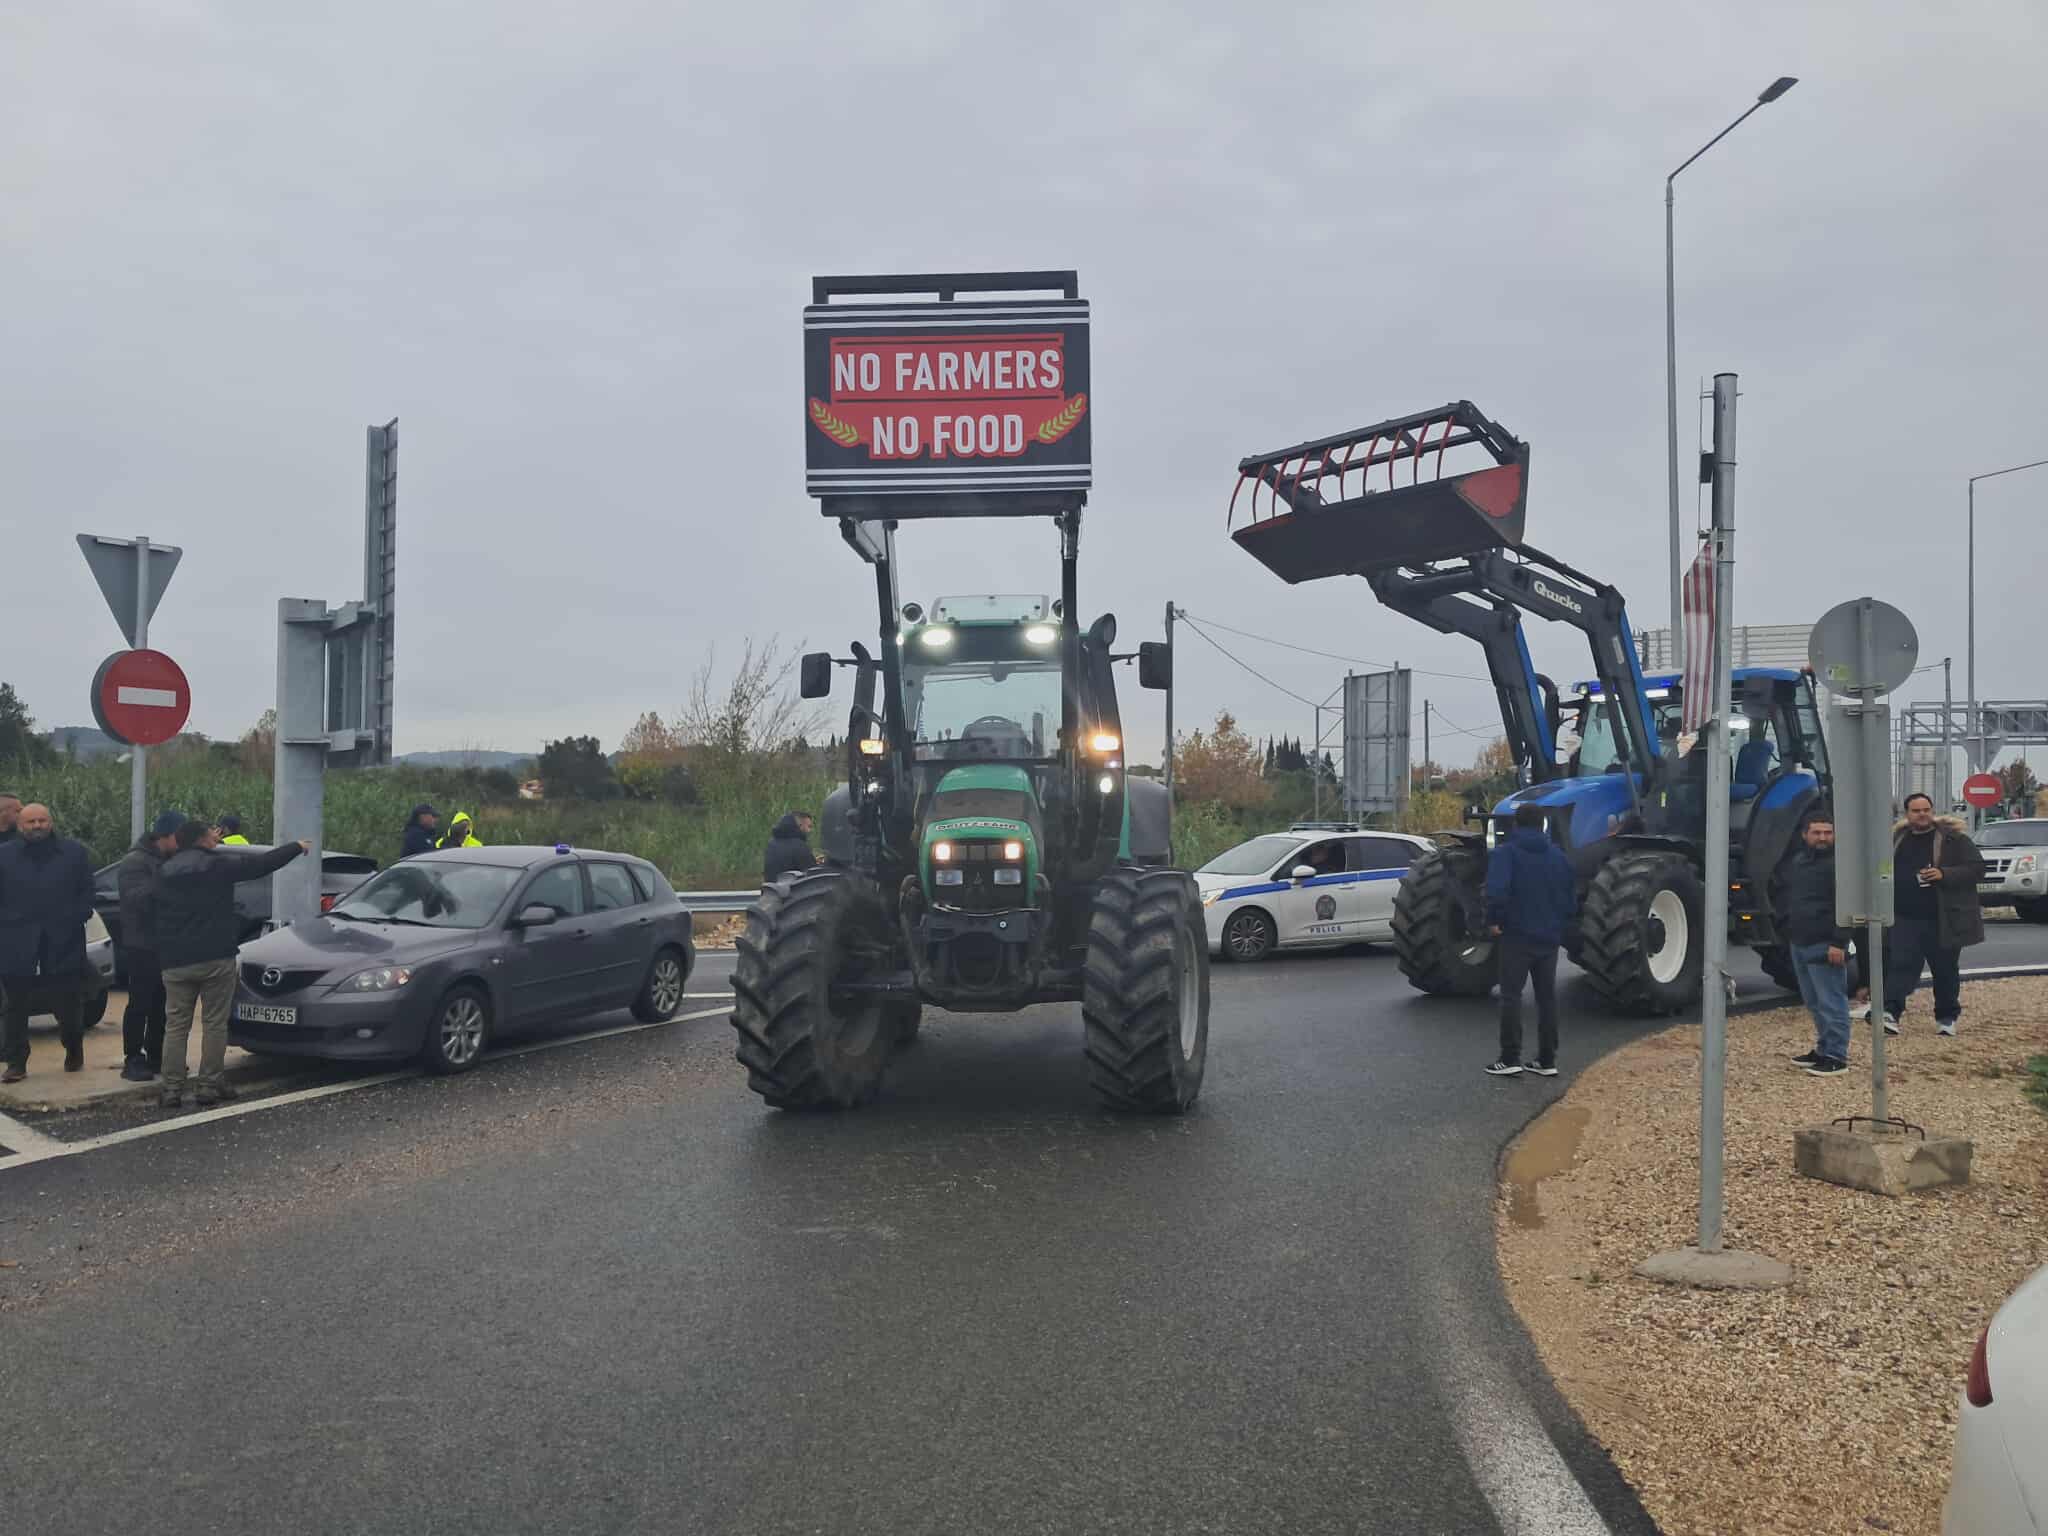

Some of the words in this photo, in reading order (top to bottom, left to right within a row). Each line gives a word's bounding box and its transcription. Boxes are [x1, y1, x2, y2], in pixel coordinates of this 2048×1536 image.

[834, 353, 881, 391] NO
[895, 350, 1061, 391] FARMERS
[872, 416, 919, 455] NO
[933, 414, 1023, 454] FOOD
[1310, 925, 1342, 934] POLICE
